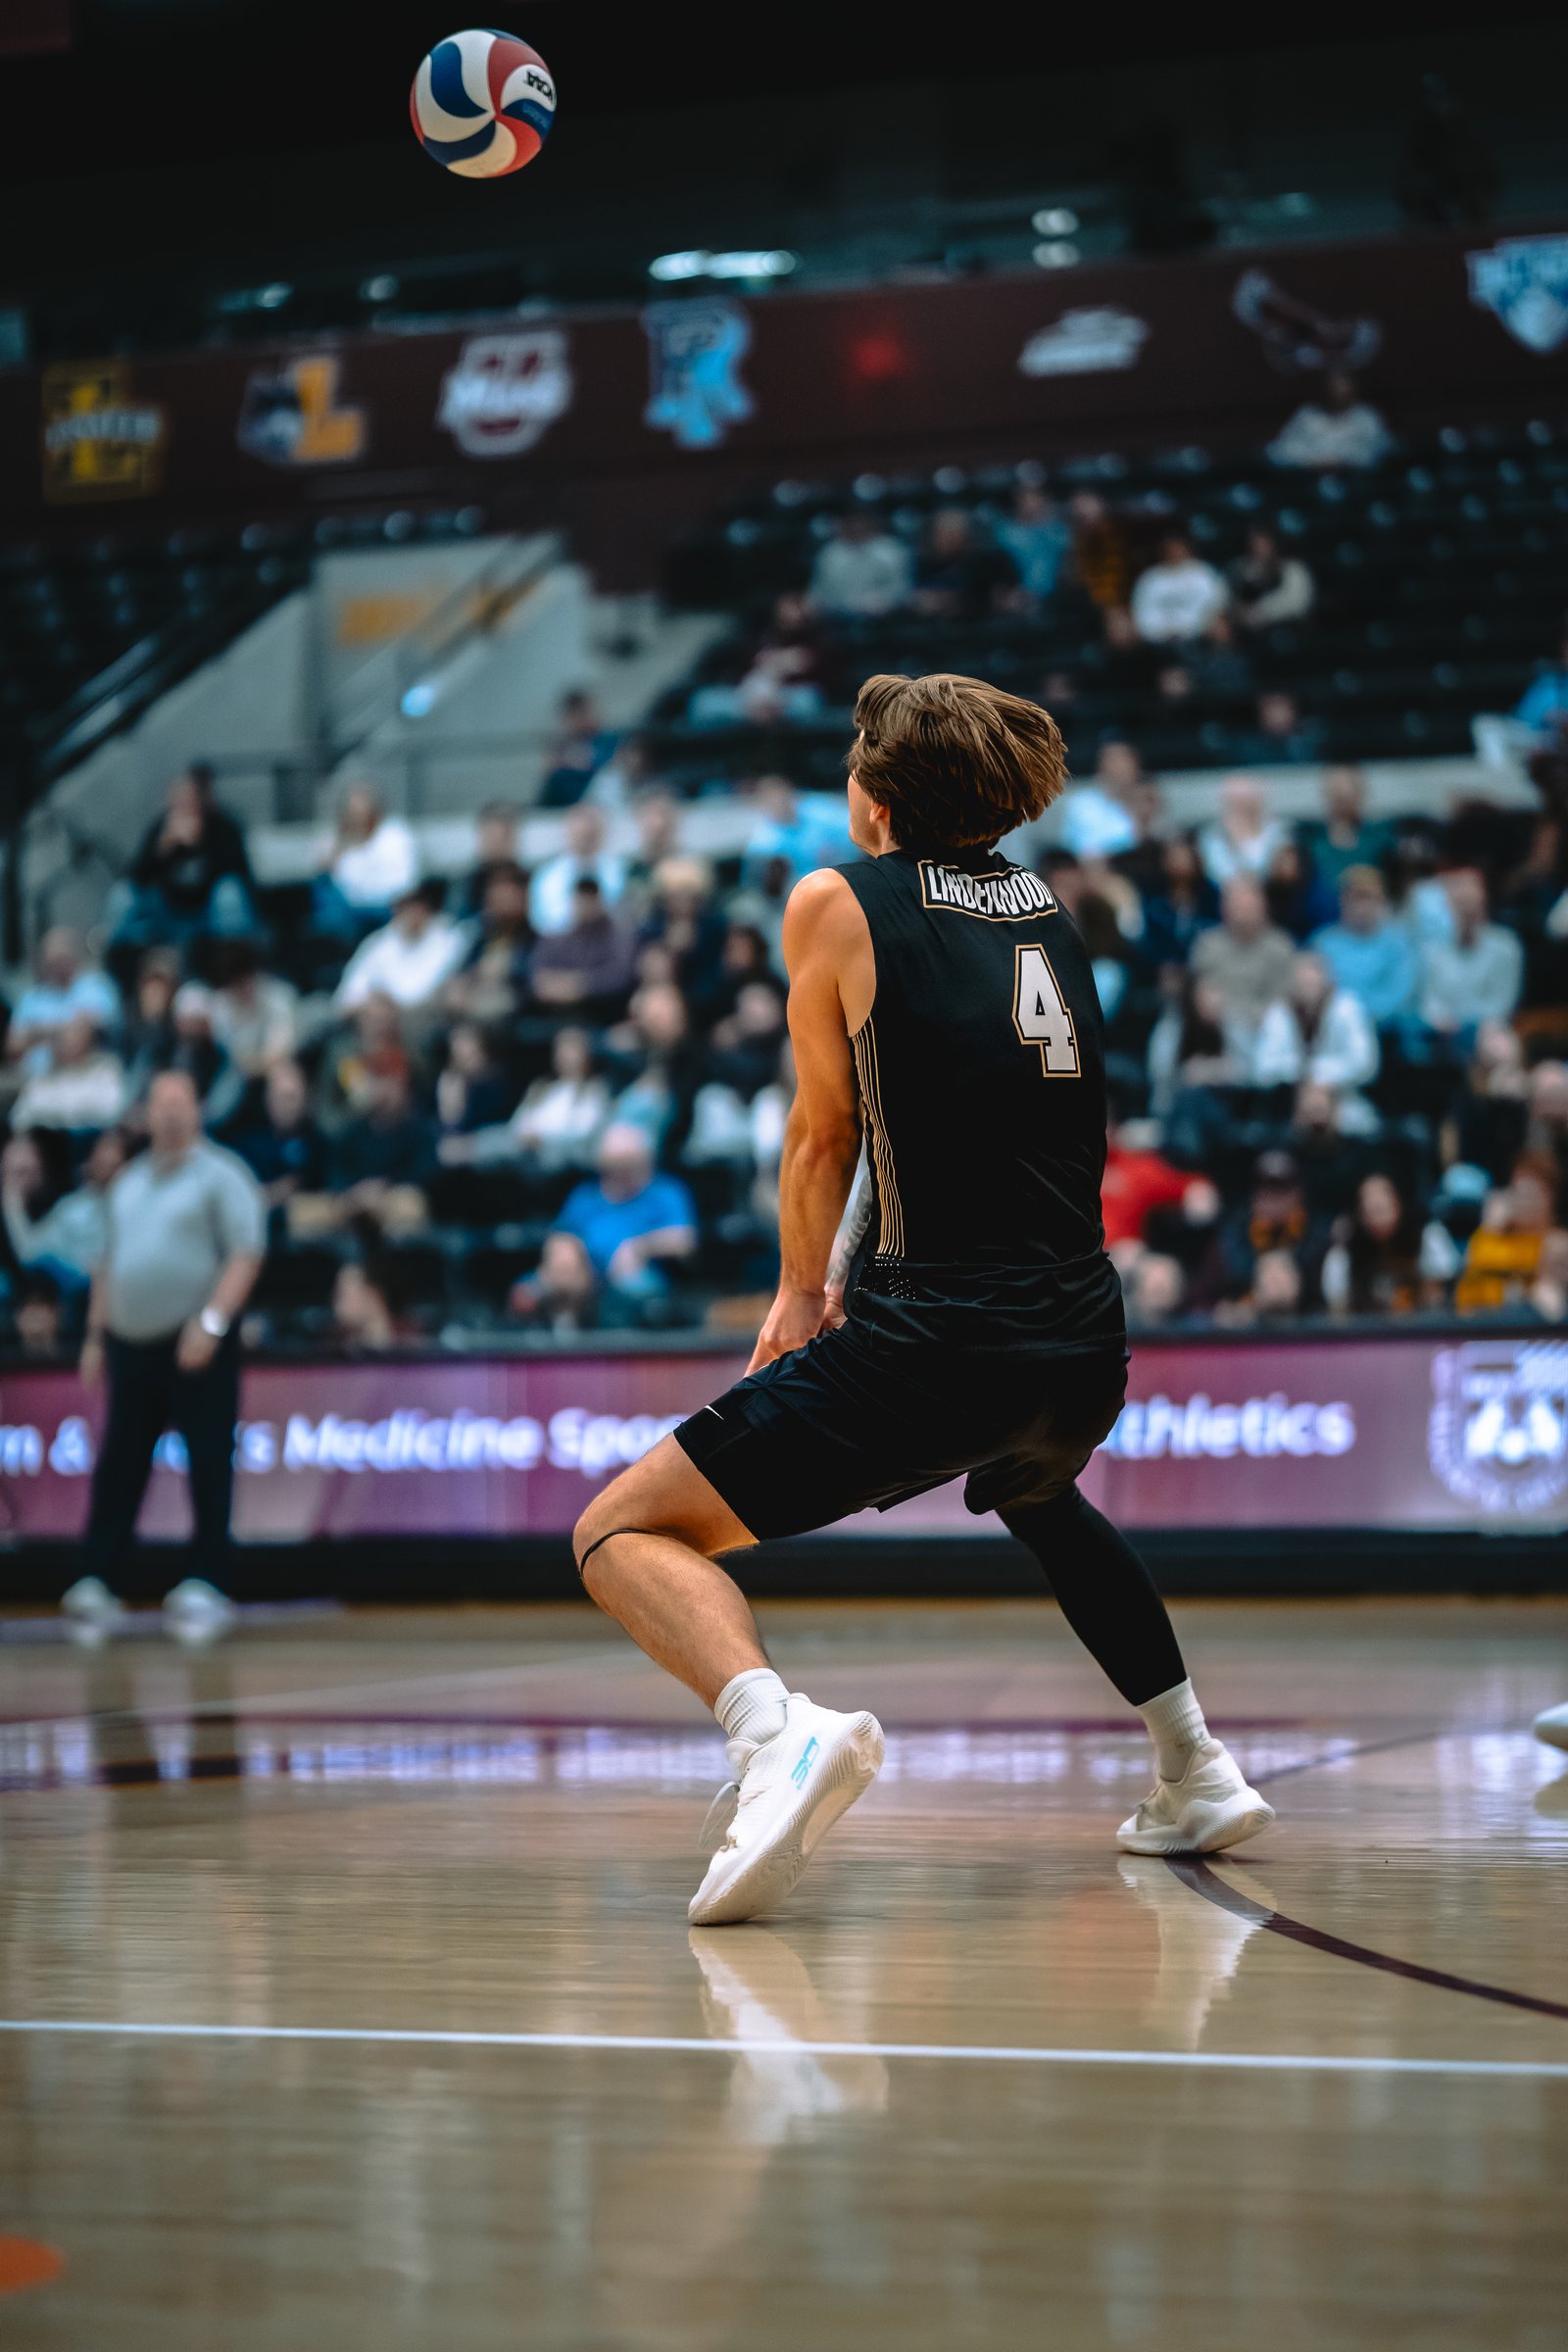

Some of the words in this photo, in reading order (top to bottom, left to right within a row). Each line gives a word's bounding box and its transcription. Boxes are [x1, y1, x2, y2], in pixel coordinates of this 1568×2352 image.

[1012, 944, 1081, 1078] 4
[284, 1409, 544, 1472] Medicine
[1099, 1392, 1356, 1458] thletics
